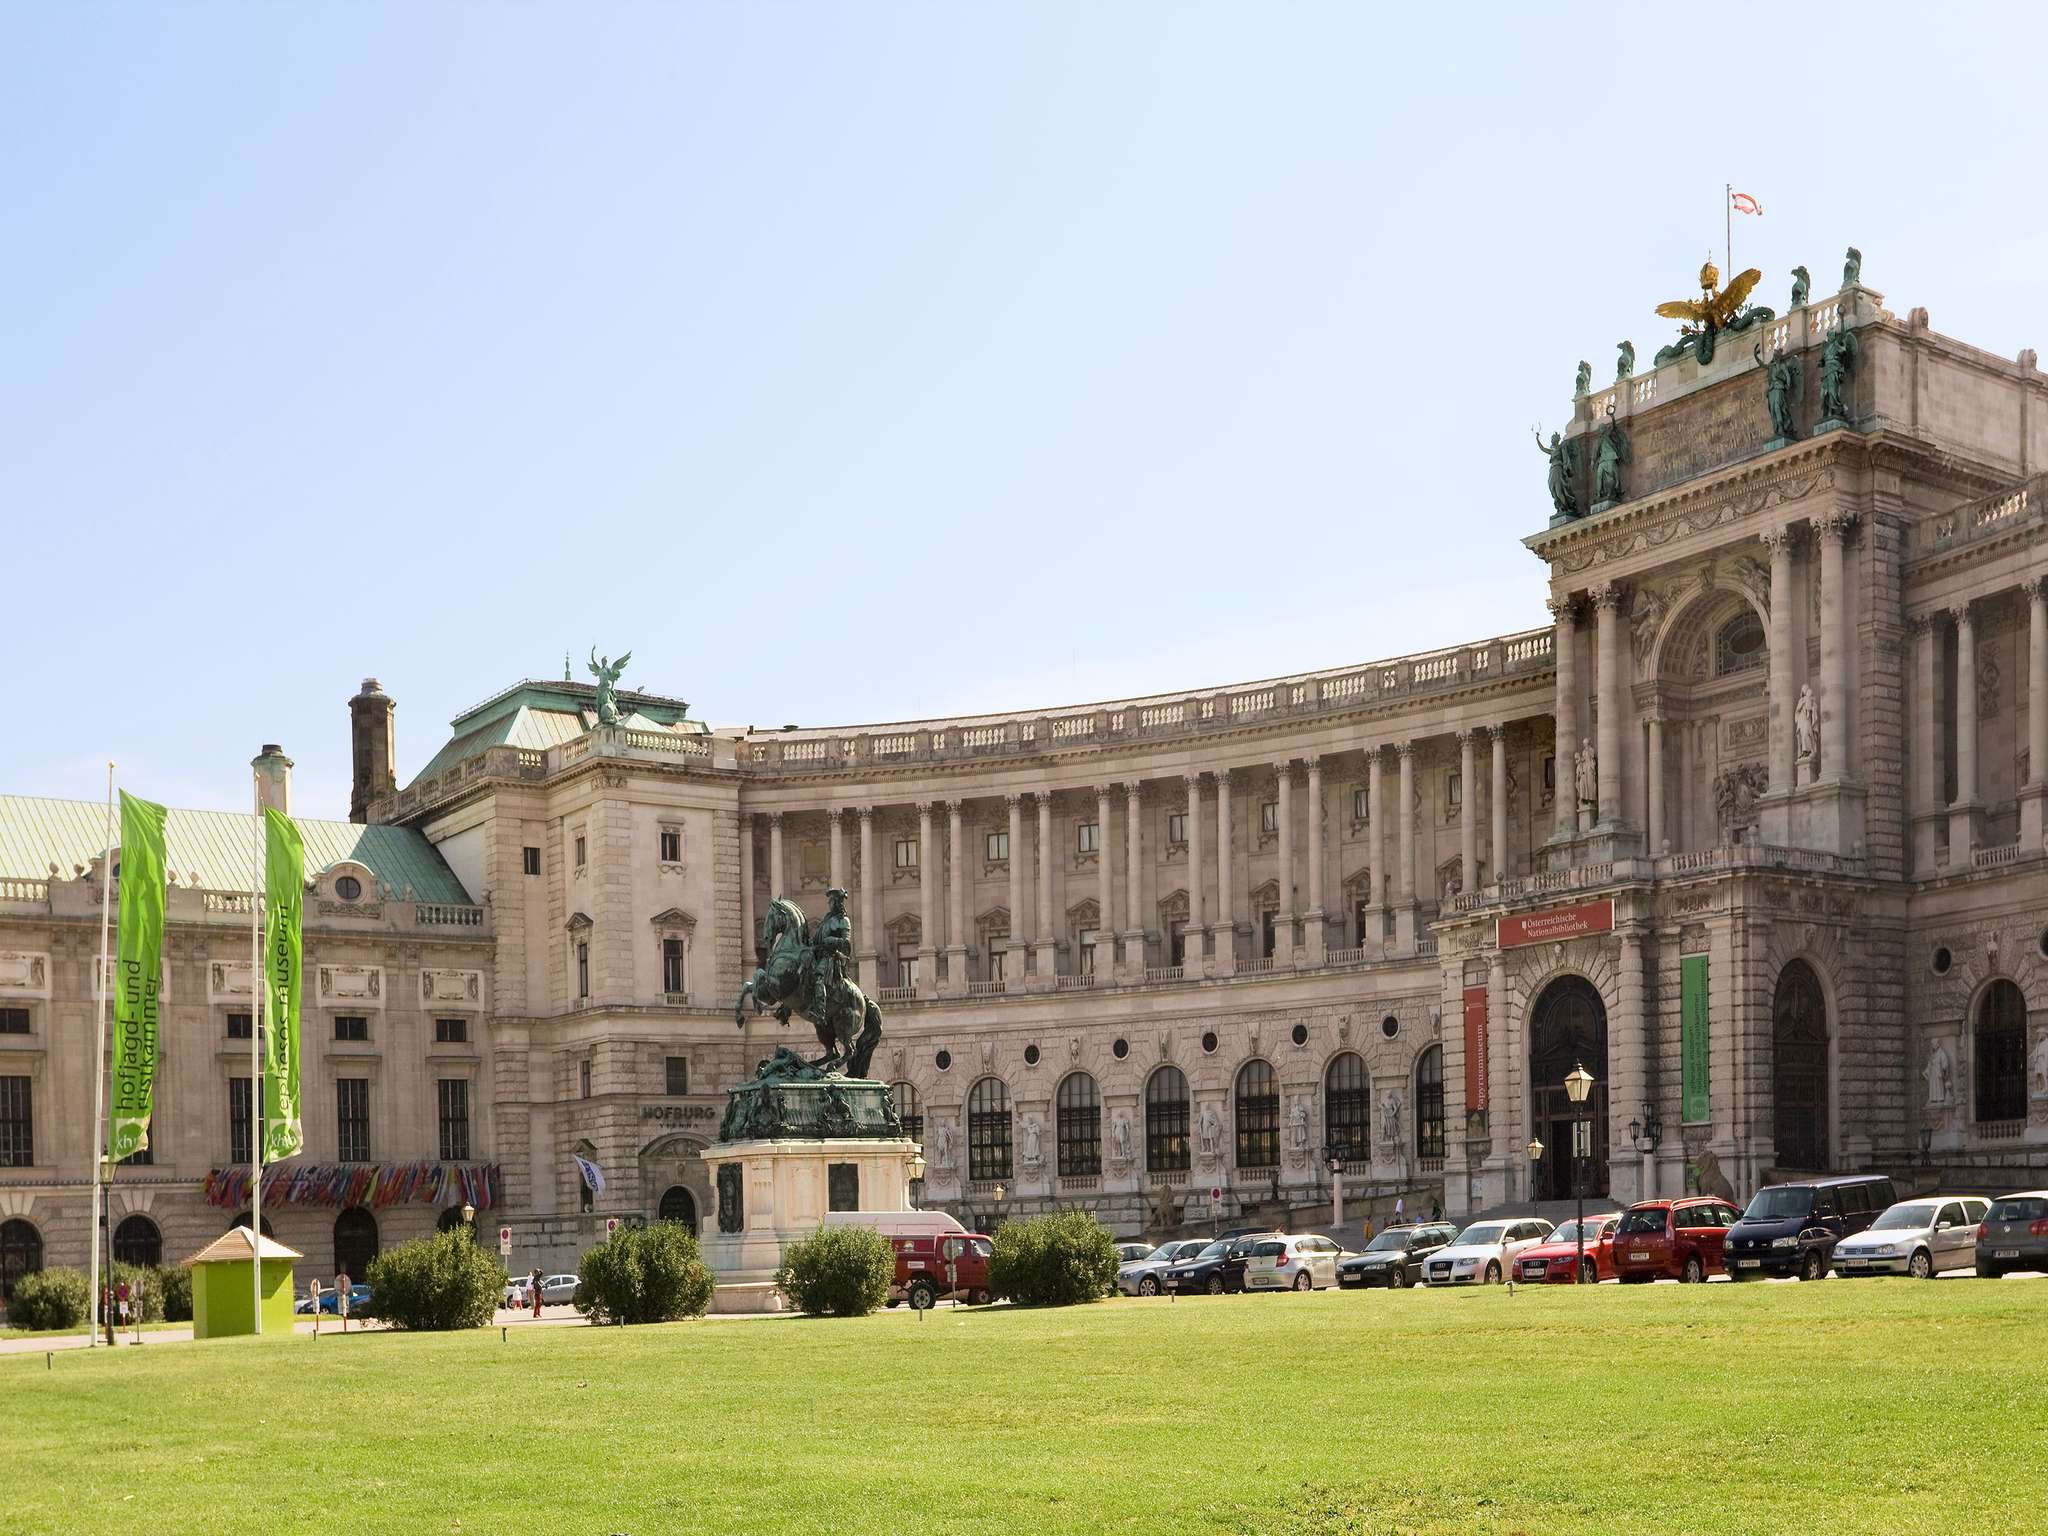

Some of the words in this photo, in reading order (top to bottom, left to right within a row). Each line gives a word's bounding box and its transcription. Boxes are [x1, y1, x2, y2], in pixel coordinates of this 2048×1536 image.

[1527, 912, 1577, 928] Österreichische
[1527, 920, 1589, 938] Nationalbibliothek
[277, 905, 289, 1005] museum
[123, 959, 141, 1004] und
[276, 1016, 290, 1110] ephesos
[1477, 1024, 1486, 1110] Papyrusmuseum
[641, 1105, 716, 1120] HOFBURG
